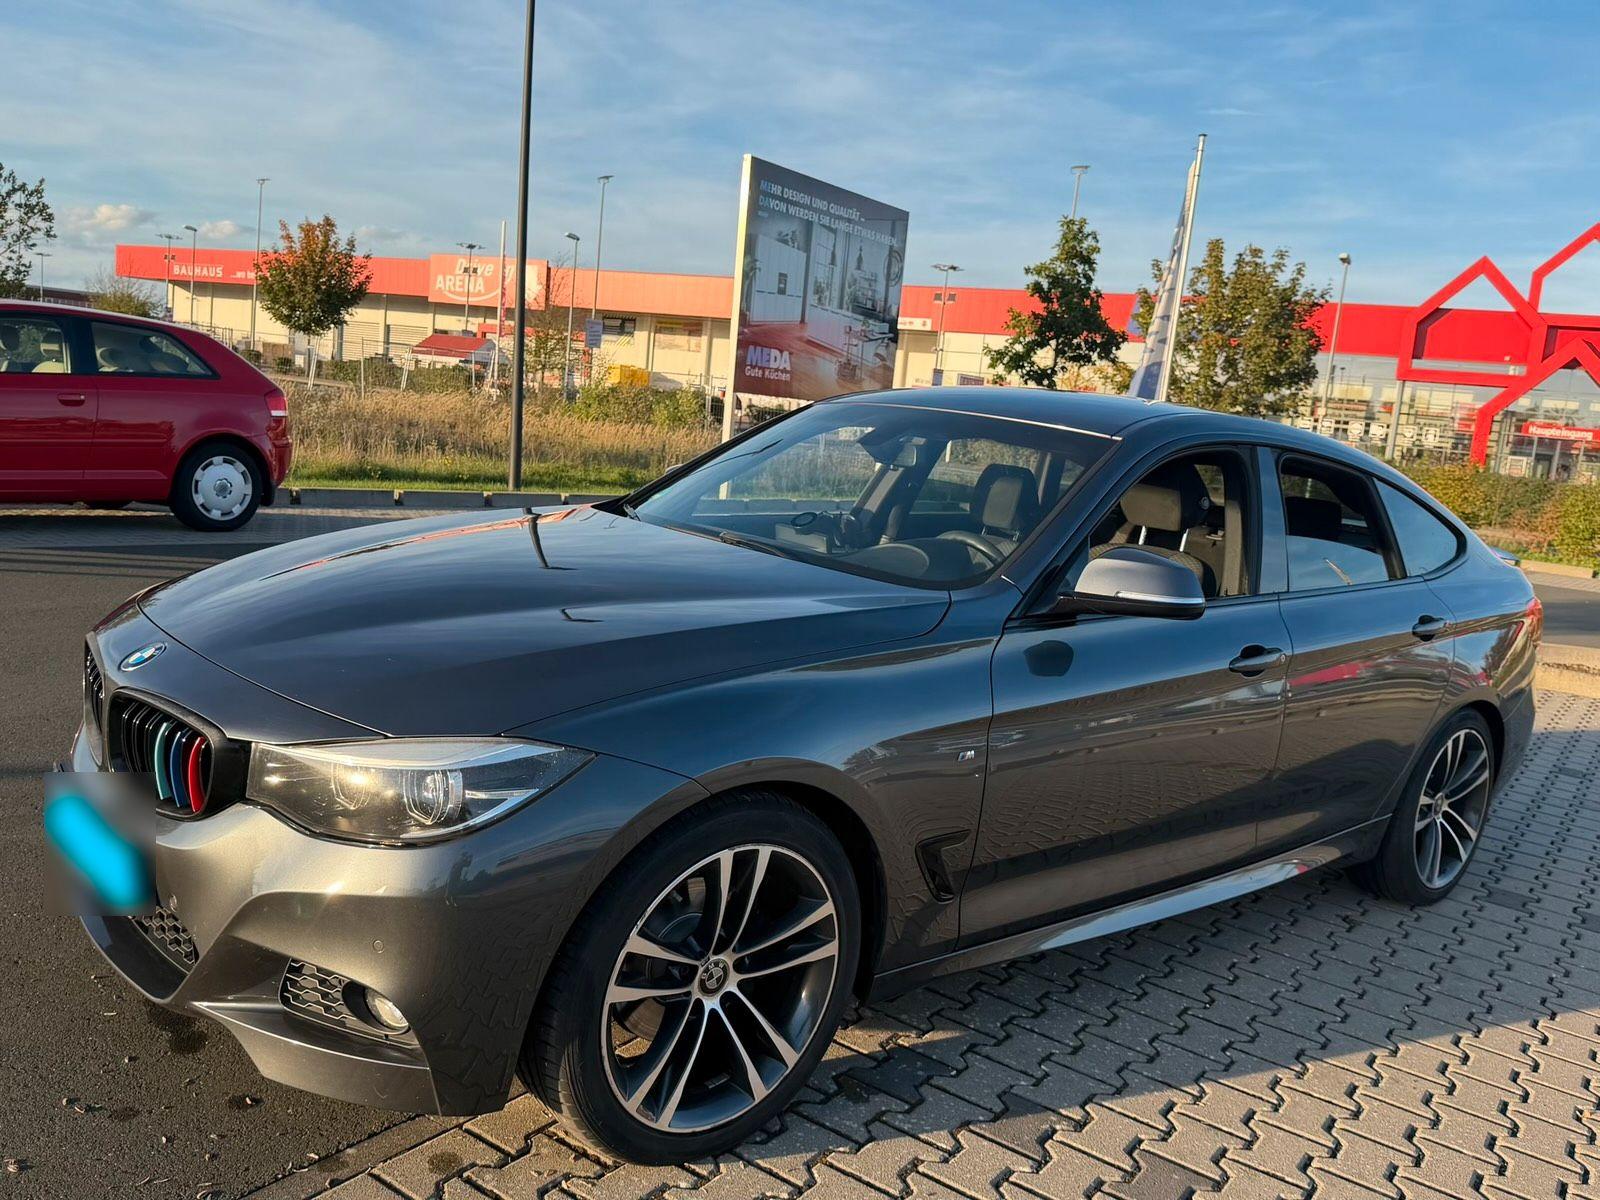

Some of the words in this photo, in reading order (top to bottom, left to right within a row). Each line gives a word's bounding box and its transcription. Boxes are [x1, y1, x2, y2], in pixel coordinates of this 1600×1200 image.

[760, 180, 782, 196] MEHR
[783, 188, 811, 205] DESIGN
[812, 197, 828, 211] UND
[829, 203, 860, 221] QUALITÄT
[759, 195, 787, 213] DAVON
[788, 204, 819, 222] WERDEN
[820, 214, 830, 225] SIE
[173, 264, 223, 278] BAUHAUS
[435, 275, 485, 293] ARENA
[746, 345, 791, 370] MEDA
[745, 366, 763, 378] Gute
[764, 368, 790, 381] Küchen
[1528, 425, 1593, 440] Haupteingang
